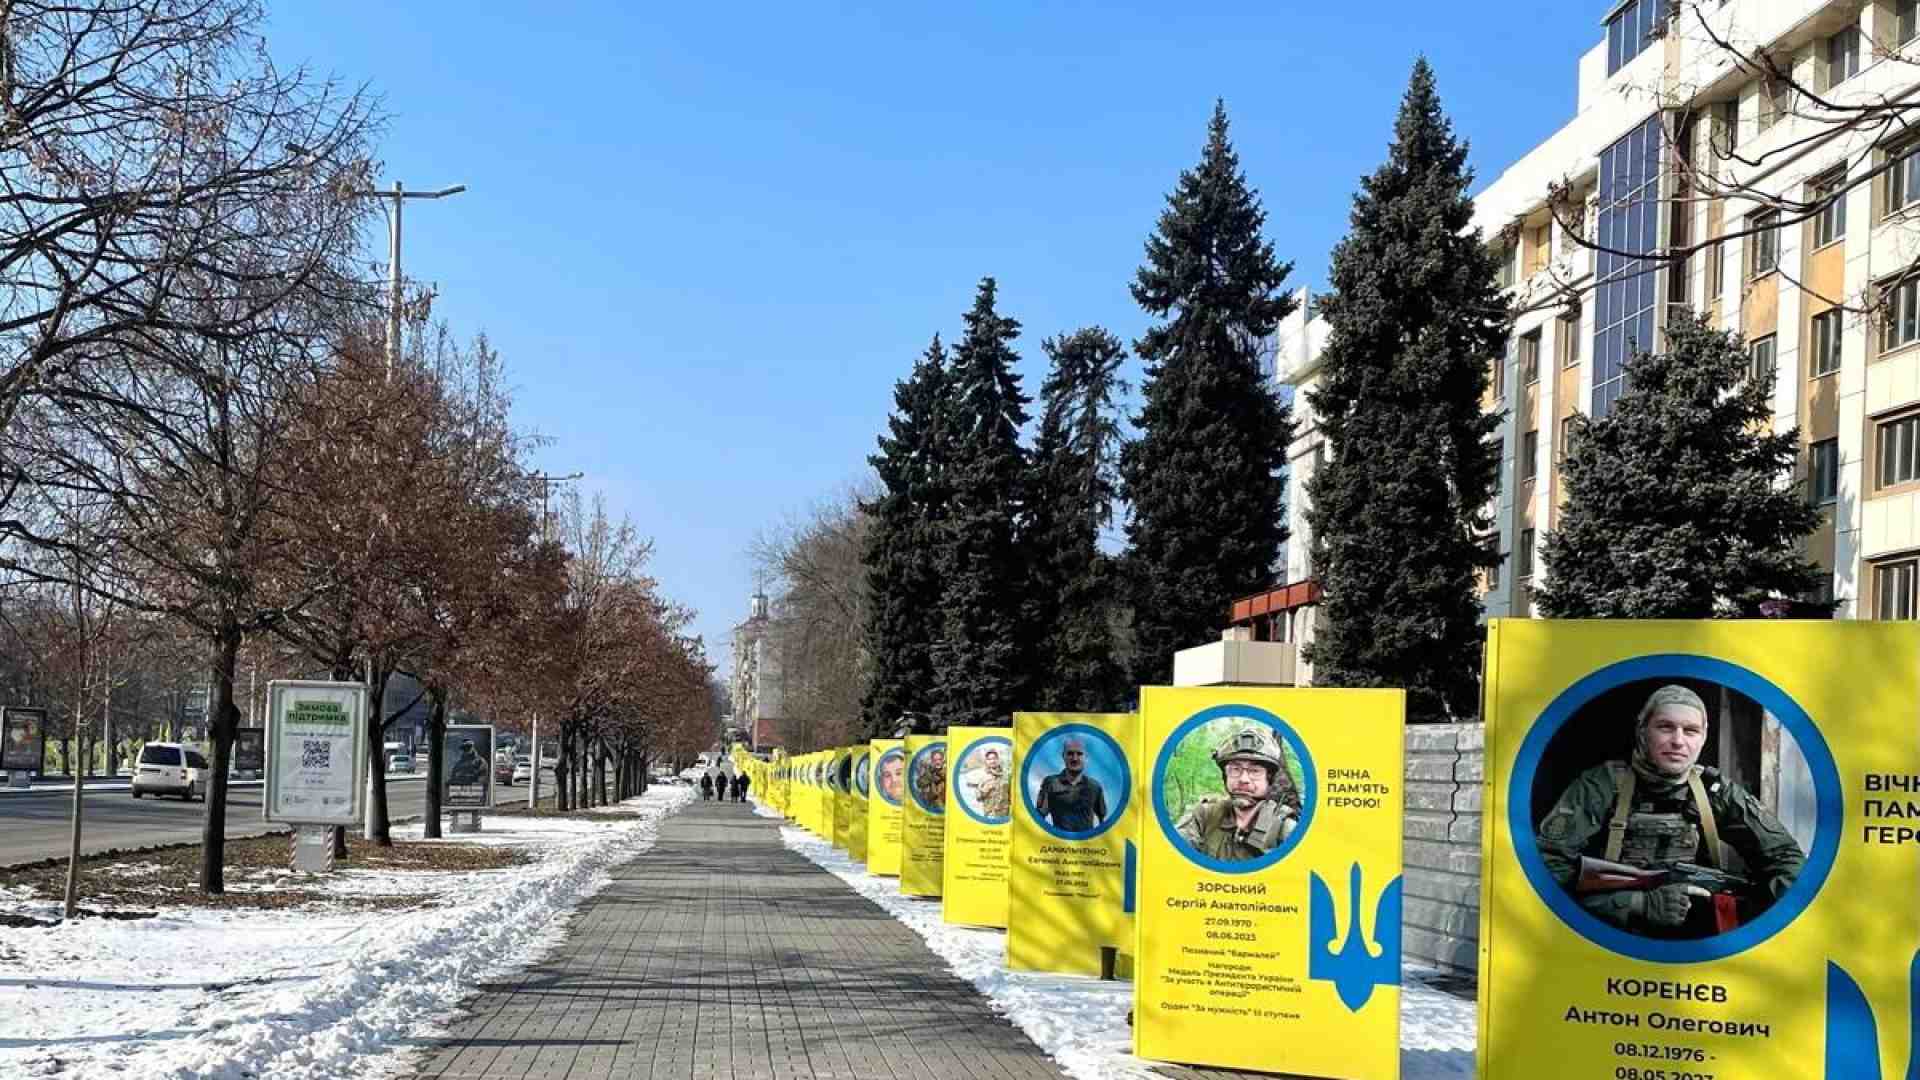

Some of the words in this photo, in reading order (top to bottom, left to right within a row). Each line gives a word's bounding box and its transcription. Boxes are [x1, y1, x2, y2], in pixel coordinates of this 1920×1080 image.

[288, 712, 346, 723] підтримка
[1328, 769, 1370, 779] ВІЧНА
[1328, 783, 1389, 794] ПАМ'ЯТЬ
[1328, 797, 1381, 808] ГЕРОЮ!
[1864, 826, 1920, 844] ГЕР
[1197, 882, 1266, 895] ЗОРСЬКИЙ
[1167, 897, 1207, 910] Сергій
[1211, 900, 1298, 913] Анатолійович
[1168, 968, 1201, 977] Медаль
[1607, 978, 1728, 1003] КОРЕНЄВ
[1565, 1005, 1640, 1027] Антон
[1648, 1012, 1770, 1038] Олегович
[1615, 1042, 1705, 1062] 08.12.1976
